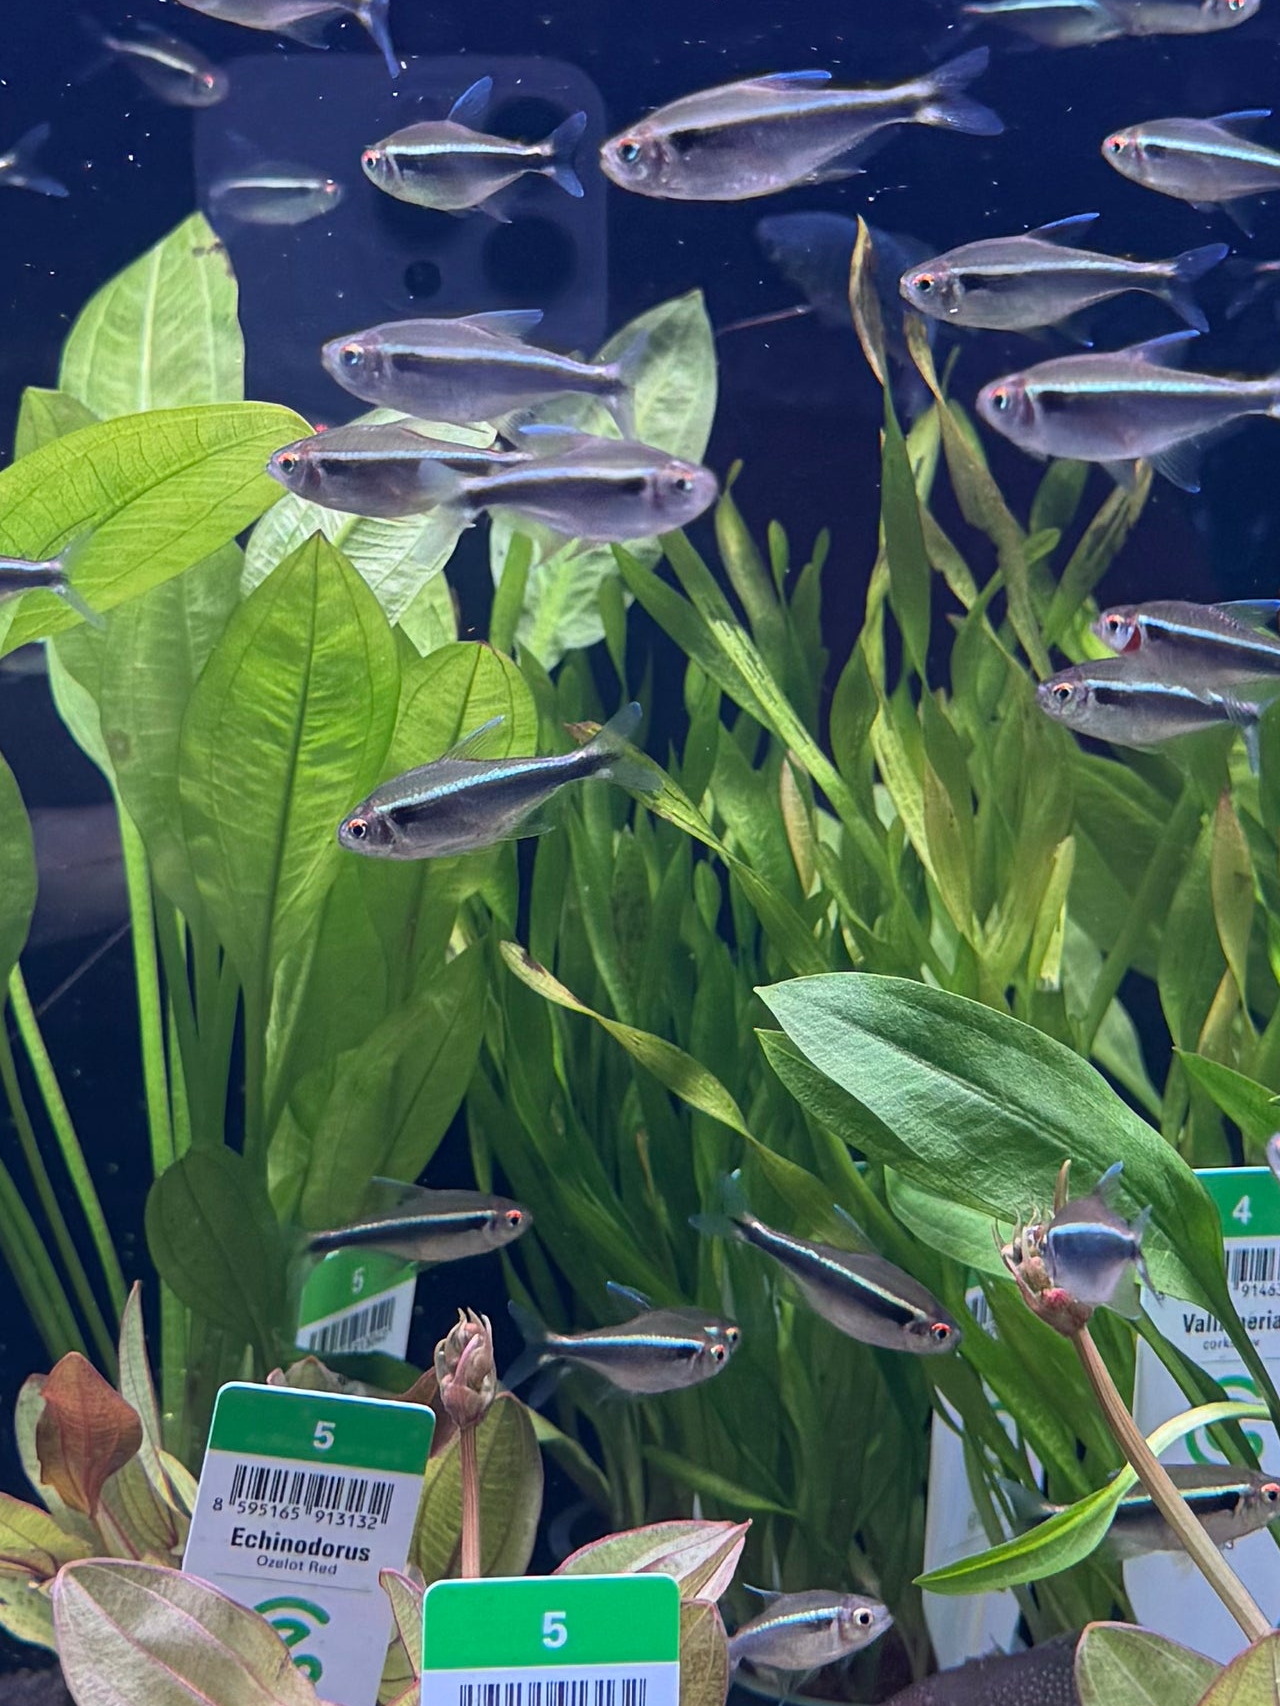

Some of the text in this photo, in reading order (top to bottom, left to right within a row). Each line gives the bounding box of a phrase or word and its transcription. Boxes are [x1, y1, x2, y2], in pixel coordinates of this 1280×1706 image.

[1232, 1195, 1253, 1225] 4
[313, 1420, 336, 1450] 5
[212, 1497, 378, 1530] 8 595165 913132
[230, 1527, 371, 1563] Echinodorus
[256, 1555, 338, 1576] Ozelot Red
[542, 1611, 568, 1649] 5
